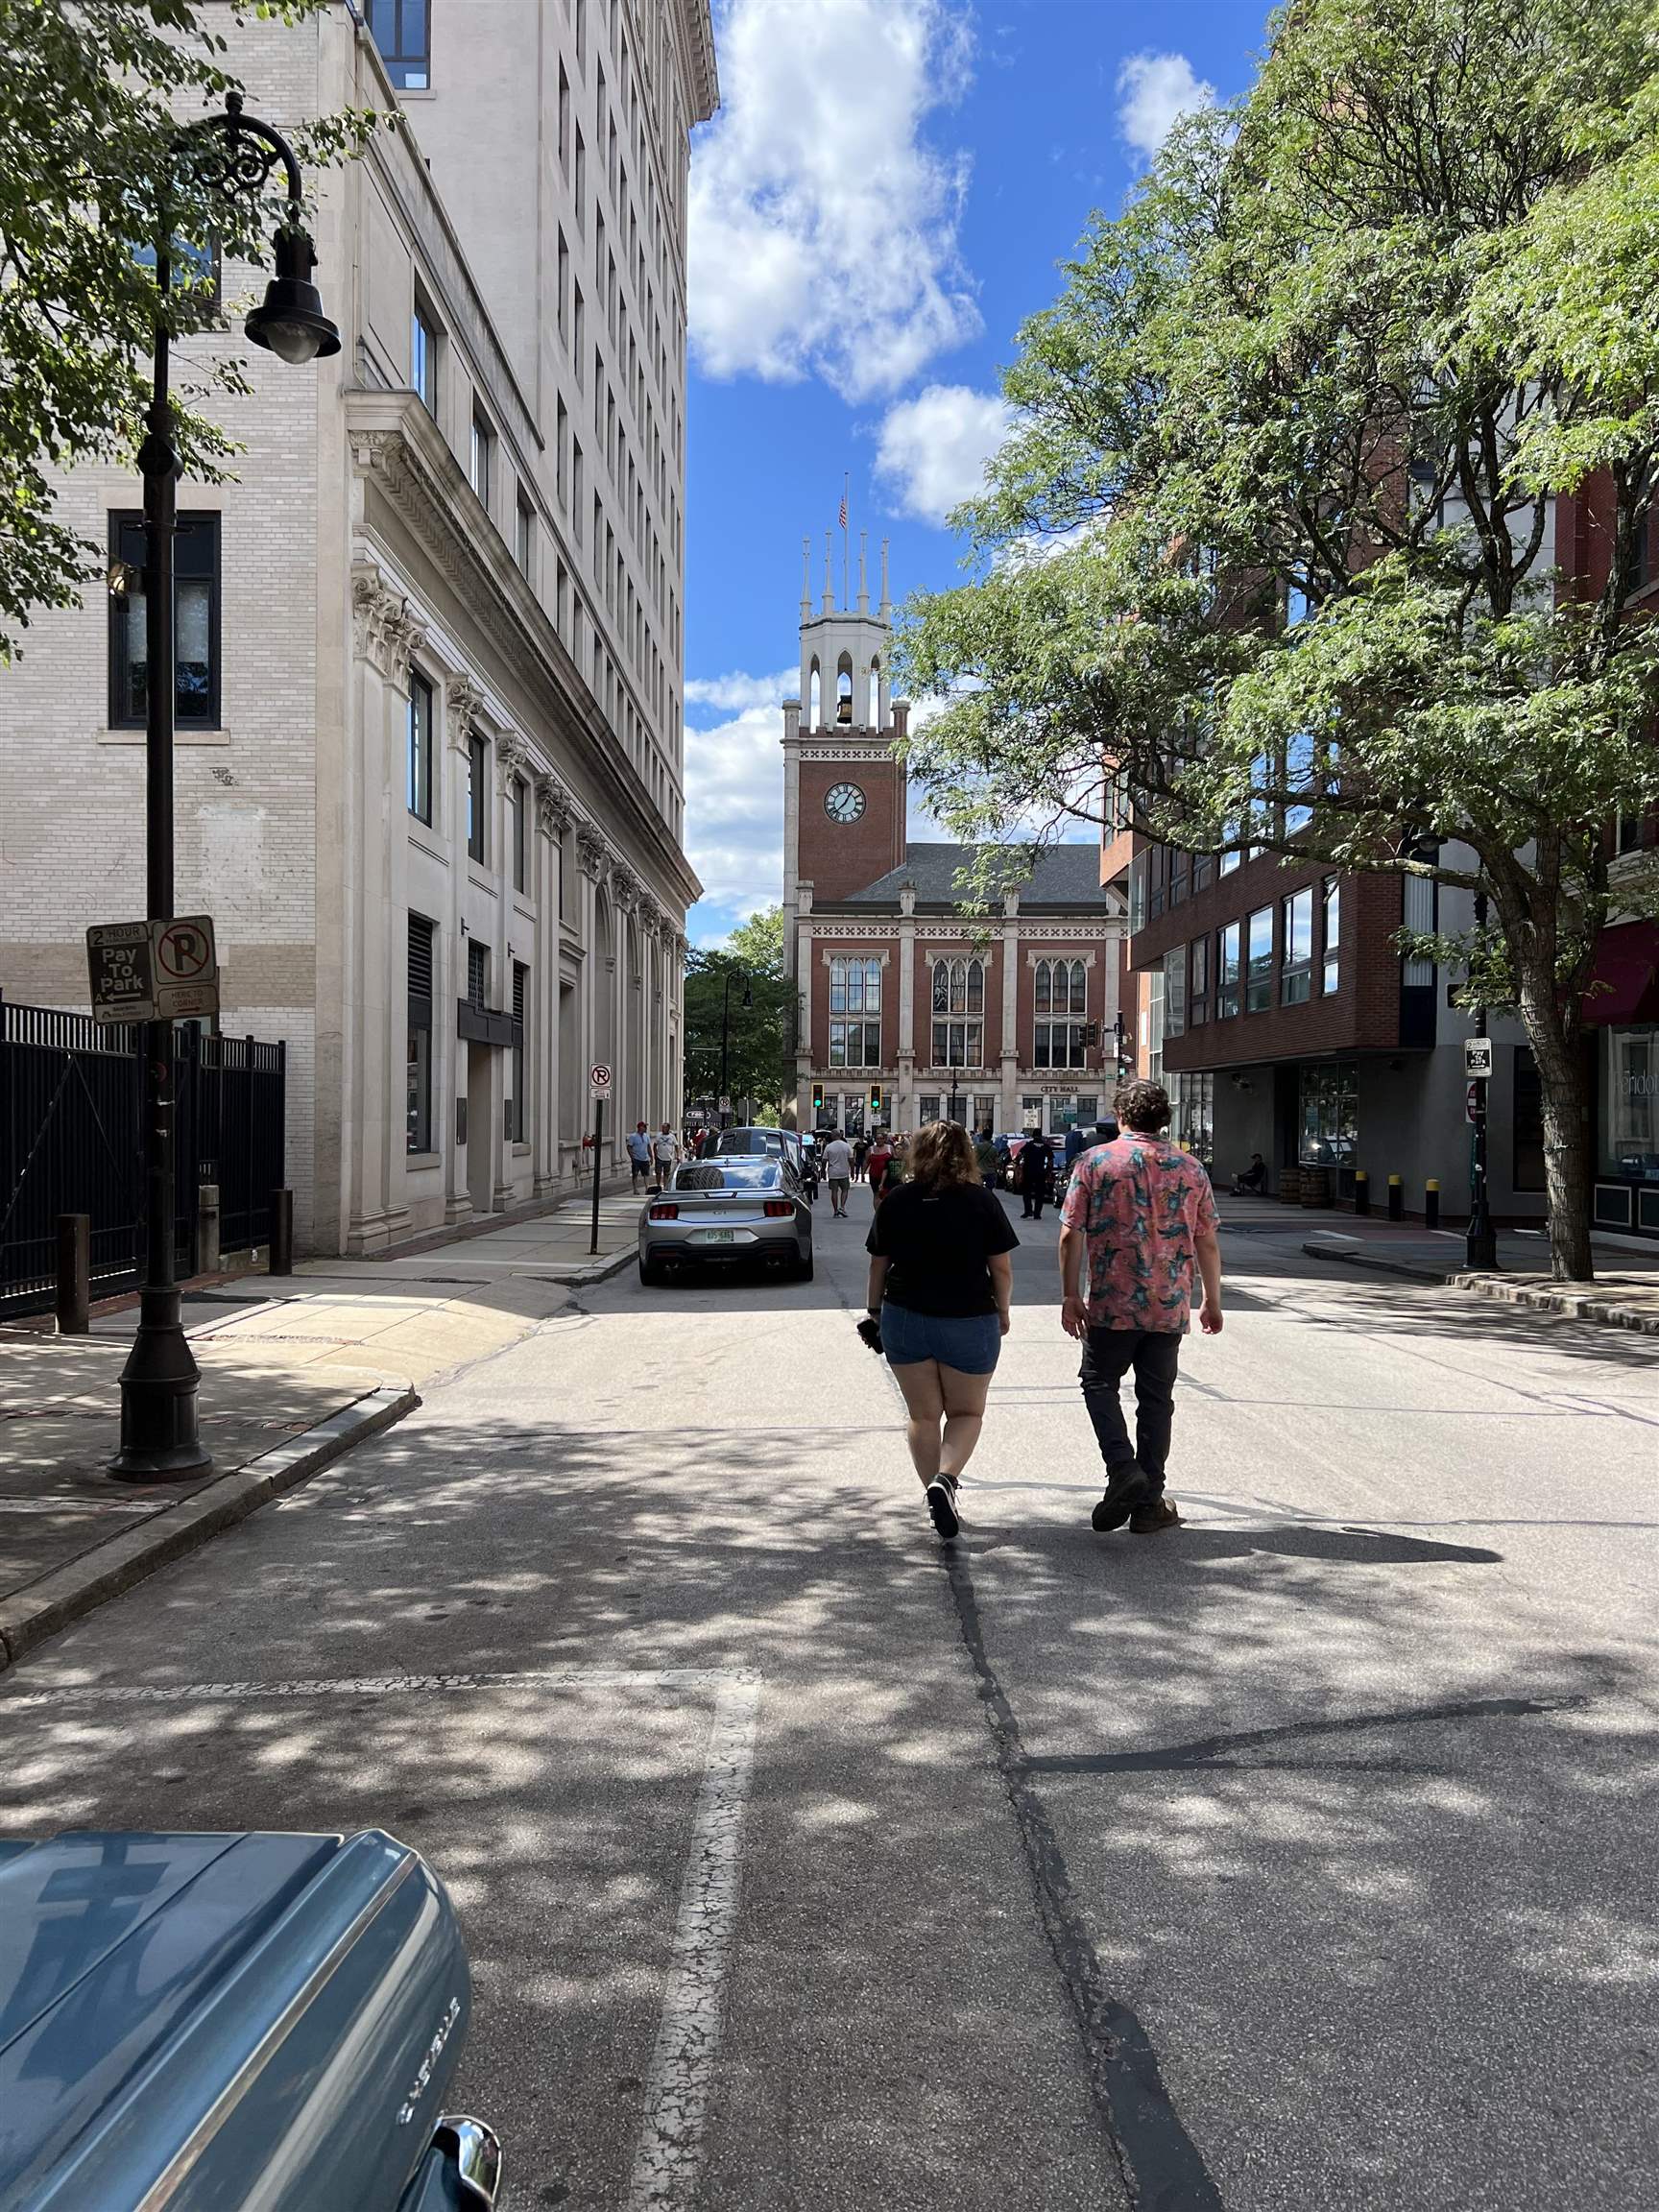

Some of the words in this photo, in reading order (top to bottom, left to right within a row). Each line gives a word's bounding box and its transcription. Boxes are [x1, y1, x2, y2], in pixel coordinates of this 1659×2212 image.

[93, 930, 104, 946] 2
[108, 926, 140, 938] HOUR
[102, 949, 136, 964] Pay
[108, 963, 133, 977] To
[100, 974, 144, 993] Park
